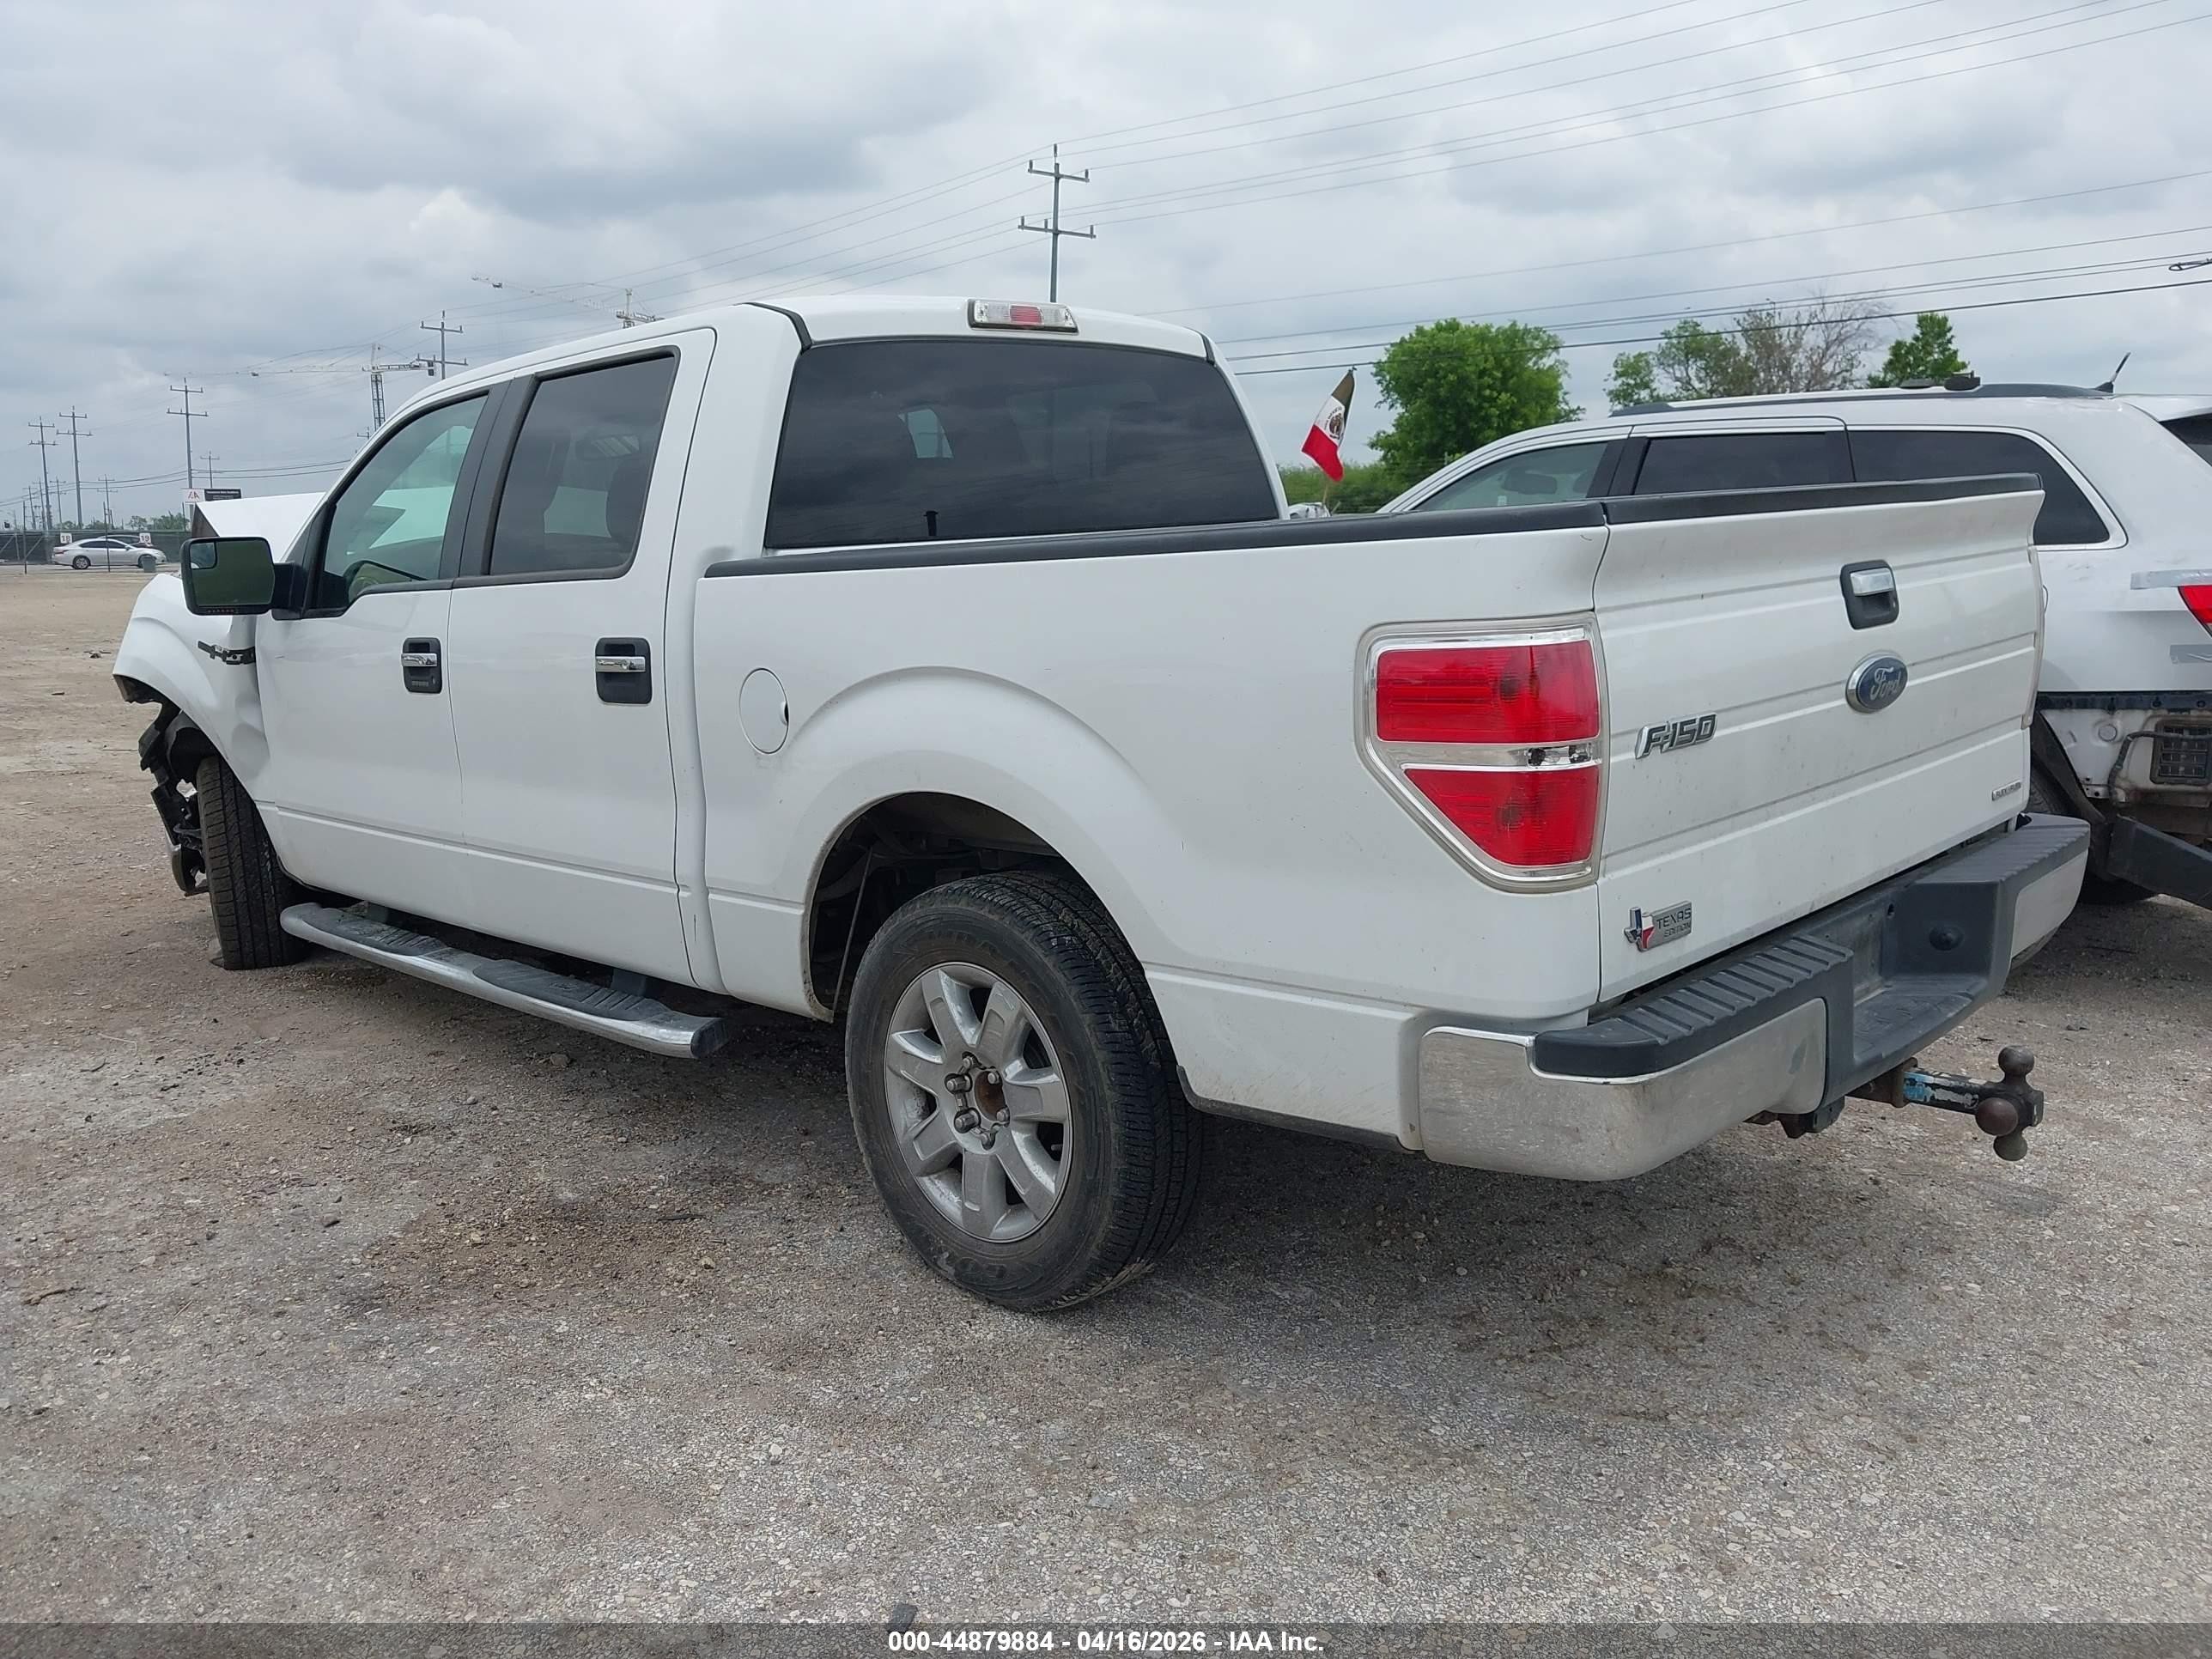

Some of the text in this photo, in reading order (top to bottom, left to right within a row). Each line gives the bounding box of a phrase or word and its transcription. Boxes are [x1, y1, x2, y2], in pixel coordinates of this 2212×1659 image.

[1869, 666, 1901, 701] Ford
[1635, 712, 1717, 760] F-150
[1656, 908, 1692, 929] TEXAS
